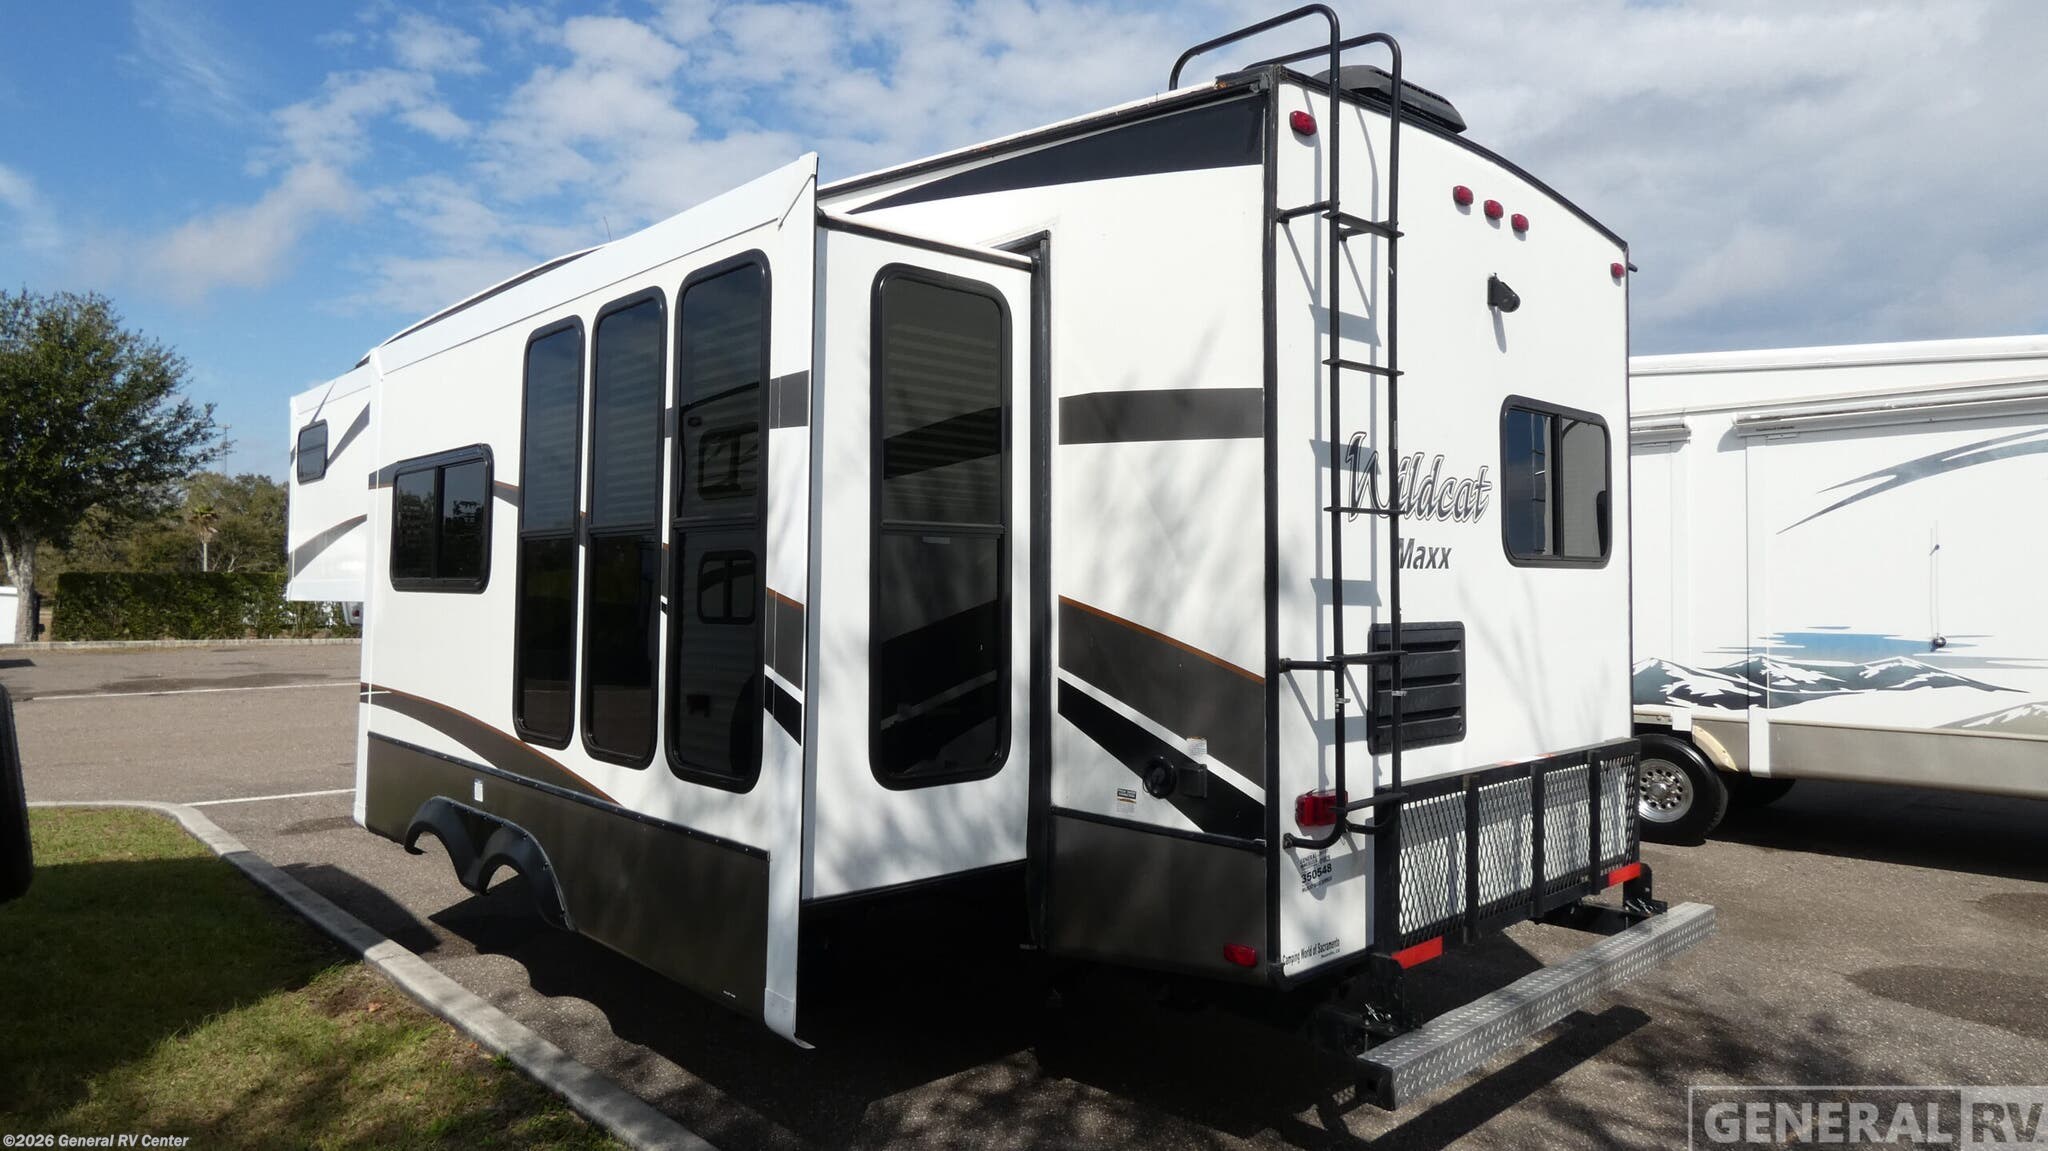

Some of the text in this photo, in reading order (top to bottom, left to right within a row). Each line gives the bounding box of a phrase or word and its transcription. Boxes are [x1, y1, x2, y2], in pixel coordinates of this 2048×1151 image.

[1301, 863, 1333, 884] 350548
[1282, 954, 1300, 966] Camping
[1301, 945, 1312, 959] World
[1317, 937, 1340, 954] Sacramento
